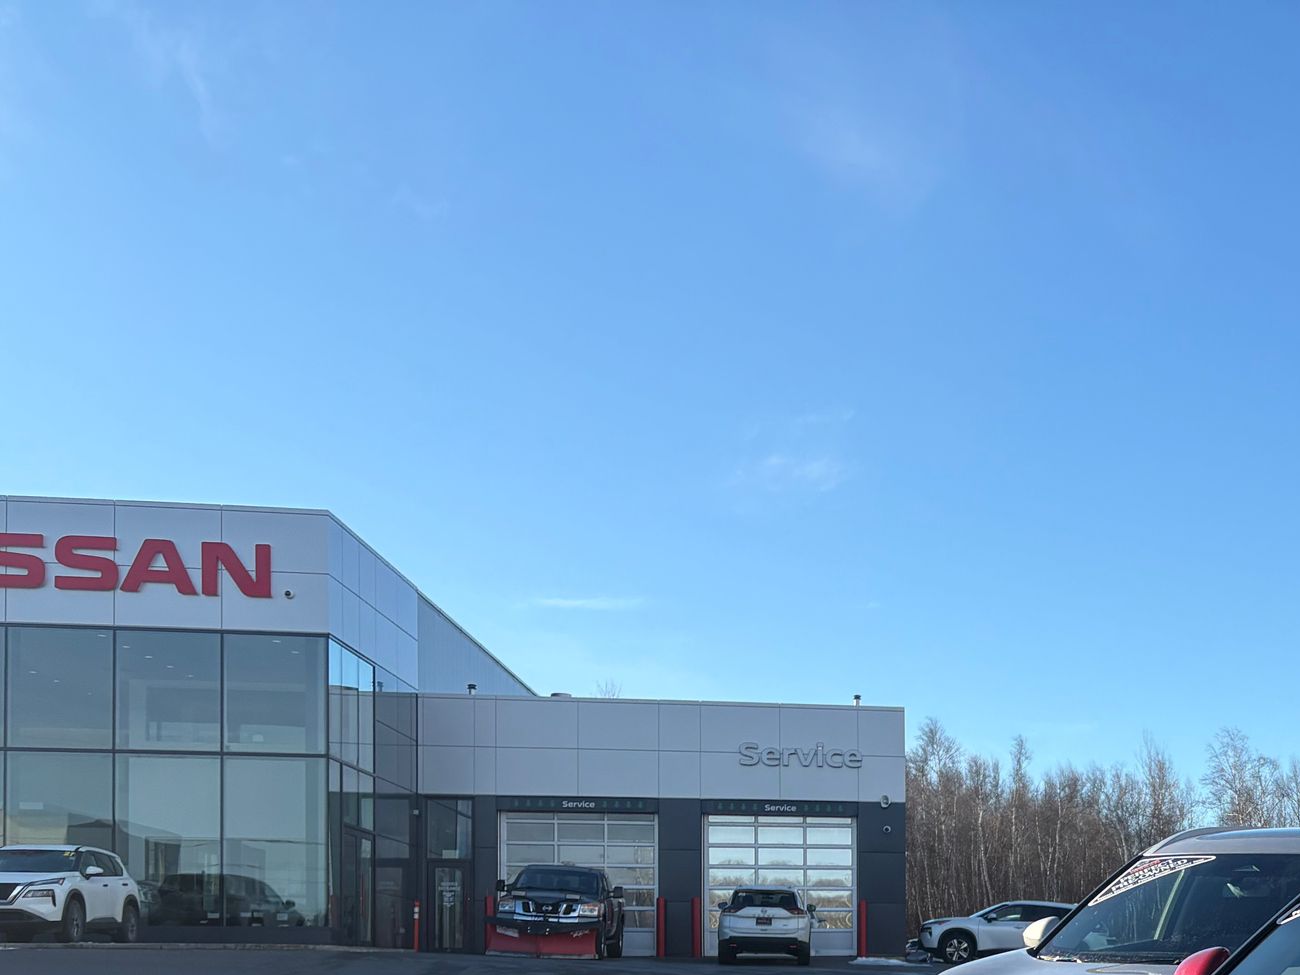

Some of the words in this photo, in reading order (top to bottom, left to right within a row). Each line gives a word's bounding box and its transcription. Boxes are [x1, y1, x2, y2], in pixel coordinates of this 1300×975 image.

[0, 533, 273, 598] SSAN
[739, 741, 863, 769] Service
[562, 800, 595, 809] Service
[764, 803, 797, 812] Service
